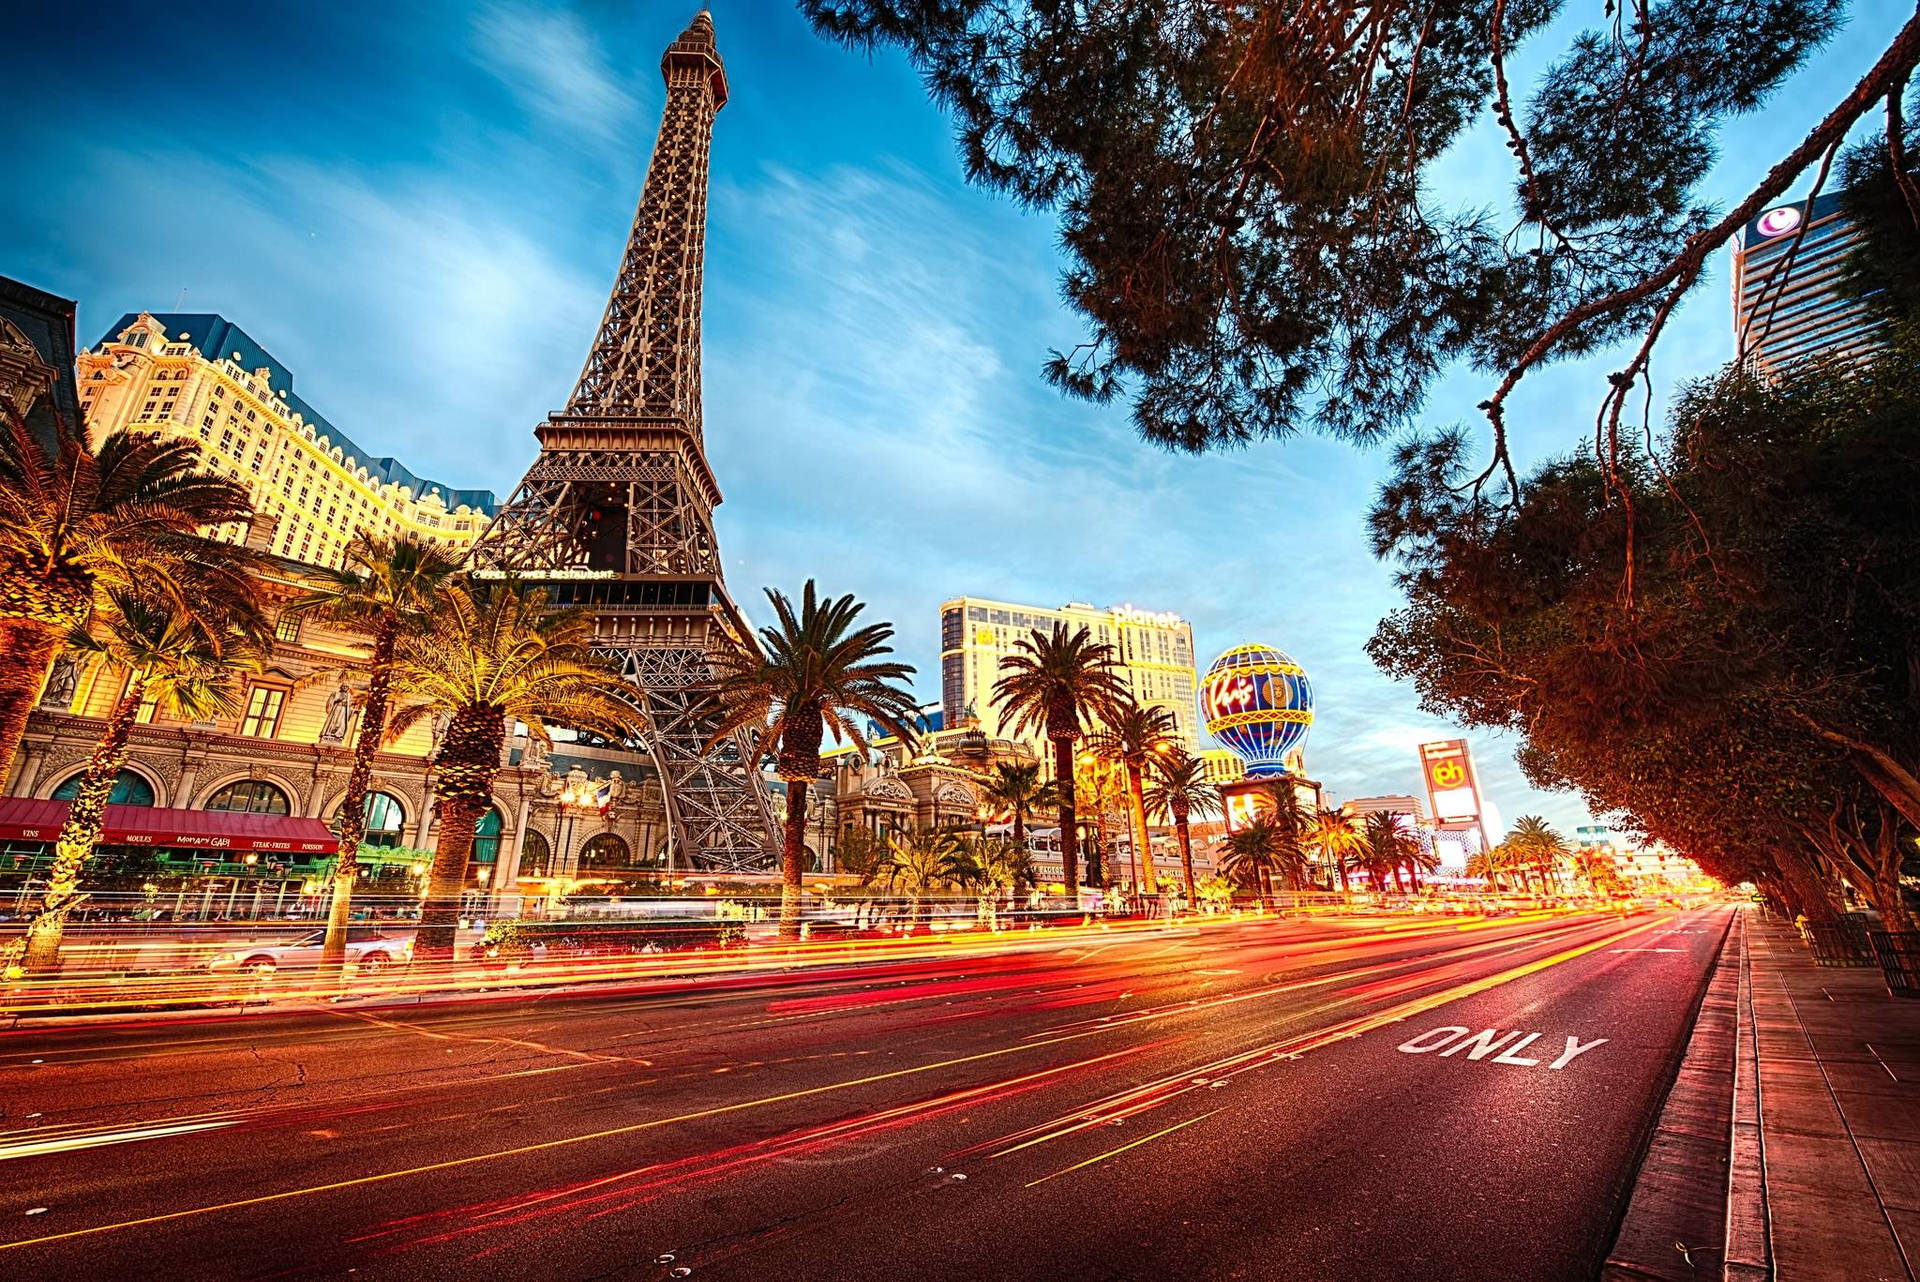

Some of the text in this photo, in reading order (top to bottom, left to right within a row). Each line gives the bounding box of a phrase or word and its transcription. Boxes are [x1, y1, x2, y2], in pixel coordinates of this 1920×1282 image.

[549, 570, 614, 580] RESTAURANT
[1111, 603, 1181, 631] planet
[1209, 669, 1254, 721] Paris
[22, 829, 39, 838] VINS
[126, 834, 153, 843] MOULES
[1397, 1025, 1610, 1070] ONLY
